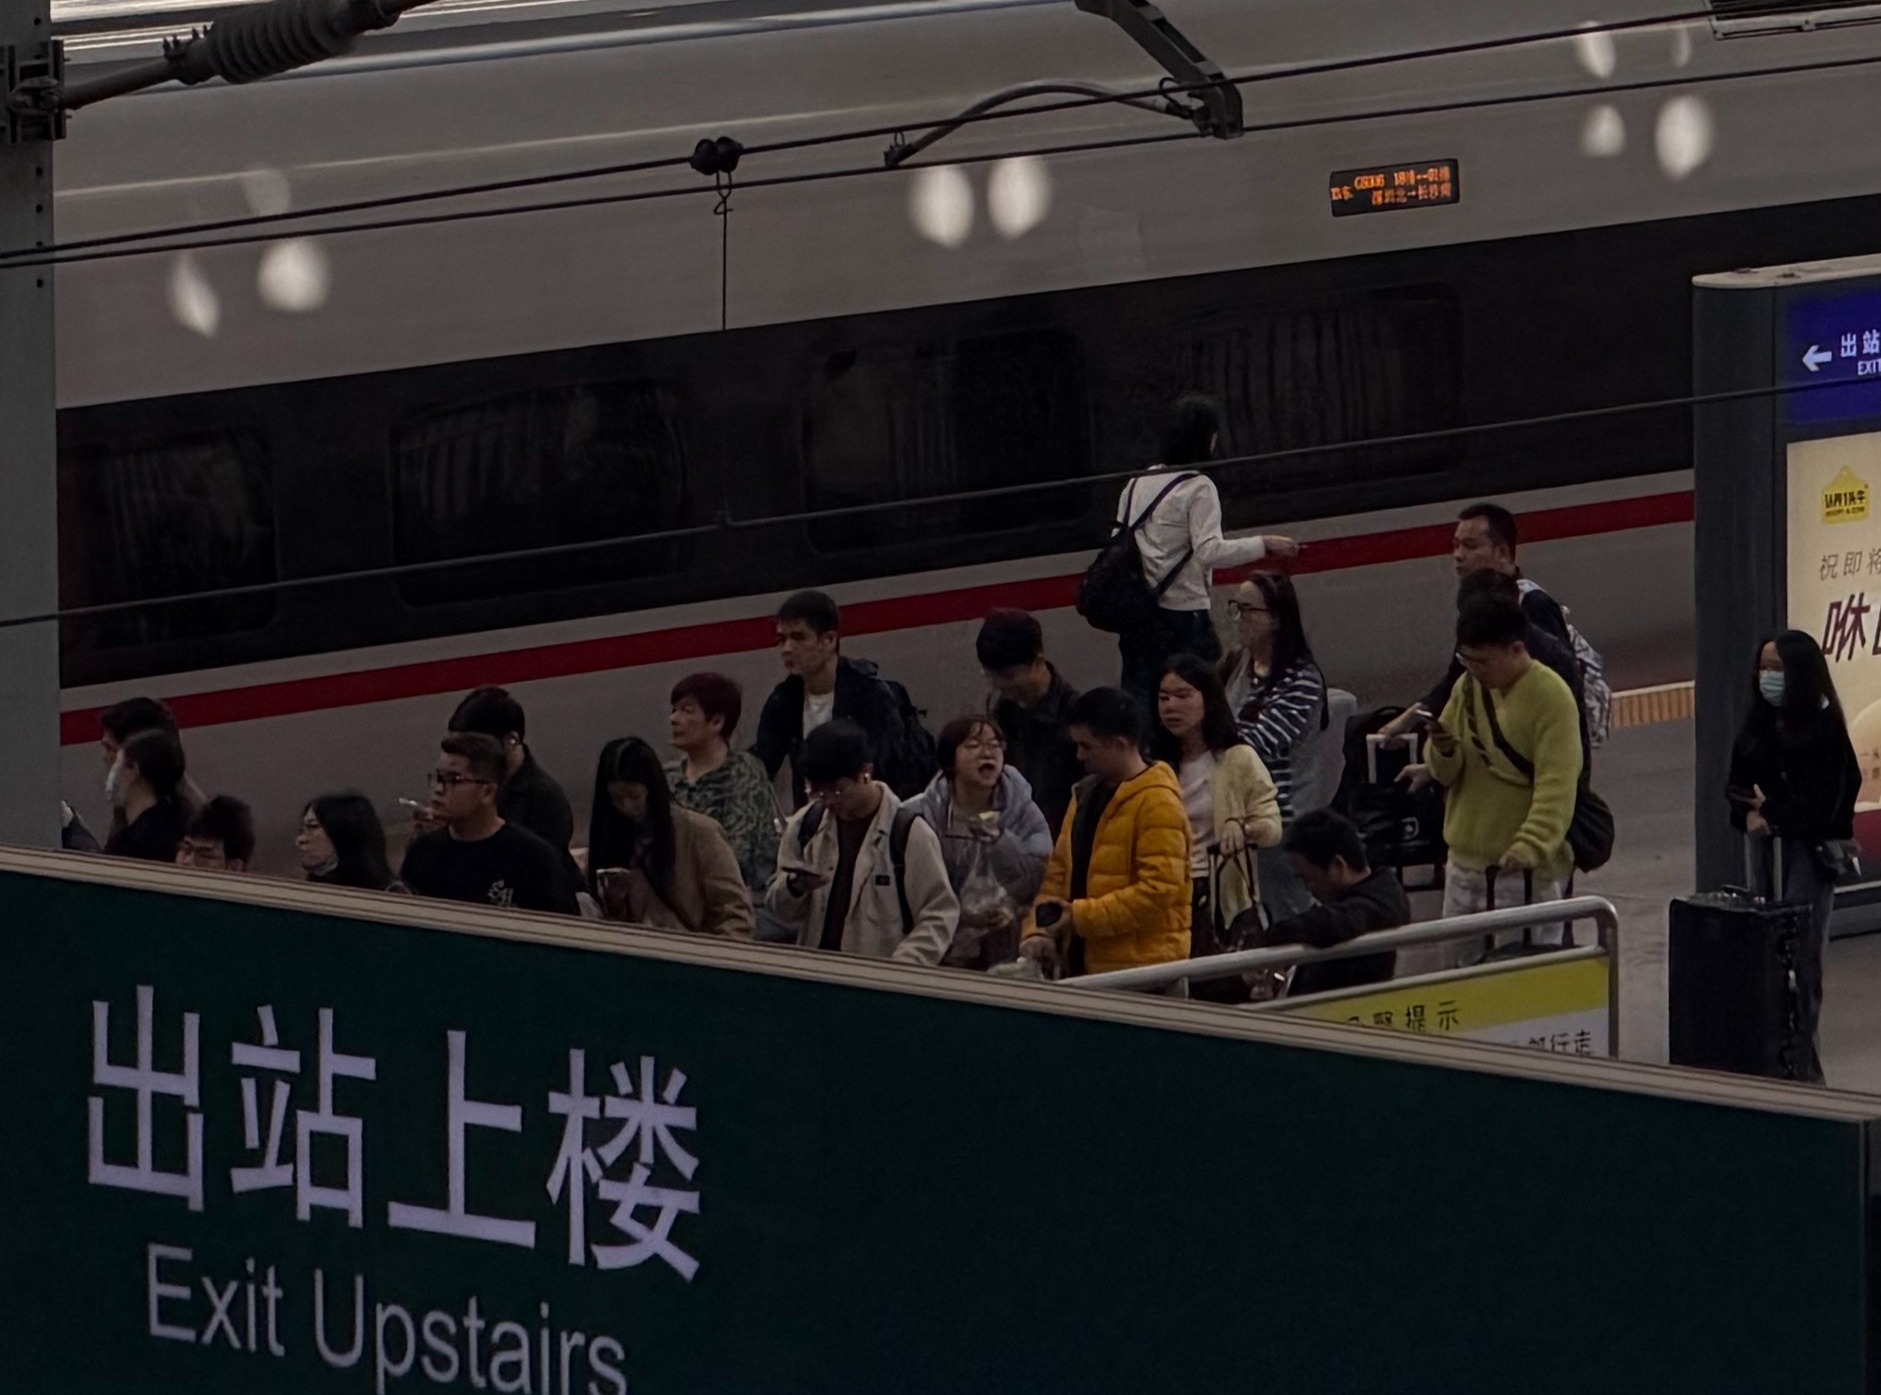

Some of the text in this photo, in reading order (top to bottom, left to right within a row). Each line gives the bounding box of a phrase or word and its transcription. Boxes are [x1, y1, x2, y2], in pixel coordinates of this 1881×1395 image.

[88, 984, 701, 1283] 出站上楼
[148, 1242, 629, 1395] Exit Upstairs
